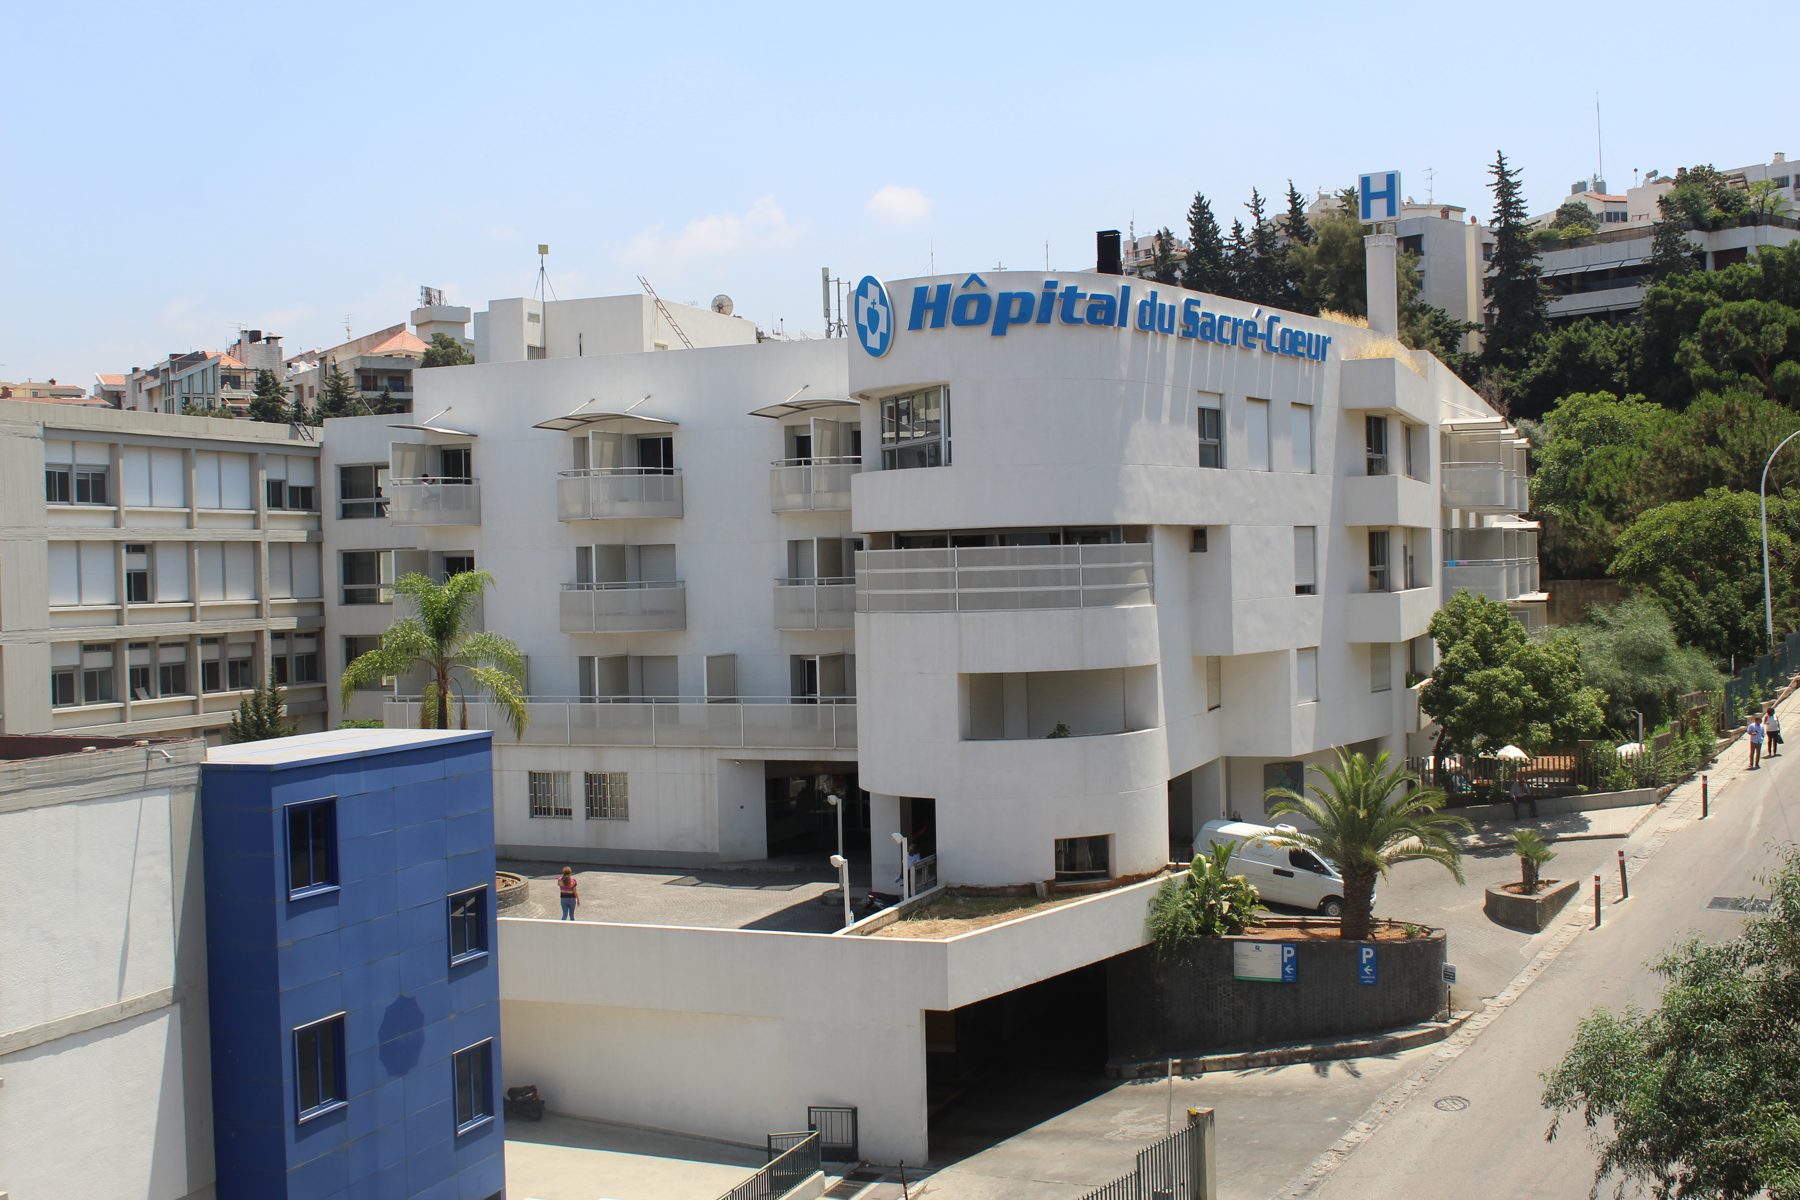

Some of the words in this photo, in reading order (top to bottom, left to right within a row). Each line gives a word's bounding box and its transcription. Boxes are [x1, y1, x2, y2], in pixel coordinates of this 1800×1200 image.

[1361, 172, 1397, 220] H
[908, 273, 1131, 337] Hôpital
[1138, 290, 1176, 334] du
[1182, 297, 1332, 362] Sacré-Cœur
[1283, 946, 1295, 963] P
[1362, 947, 1374, 964] P
